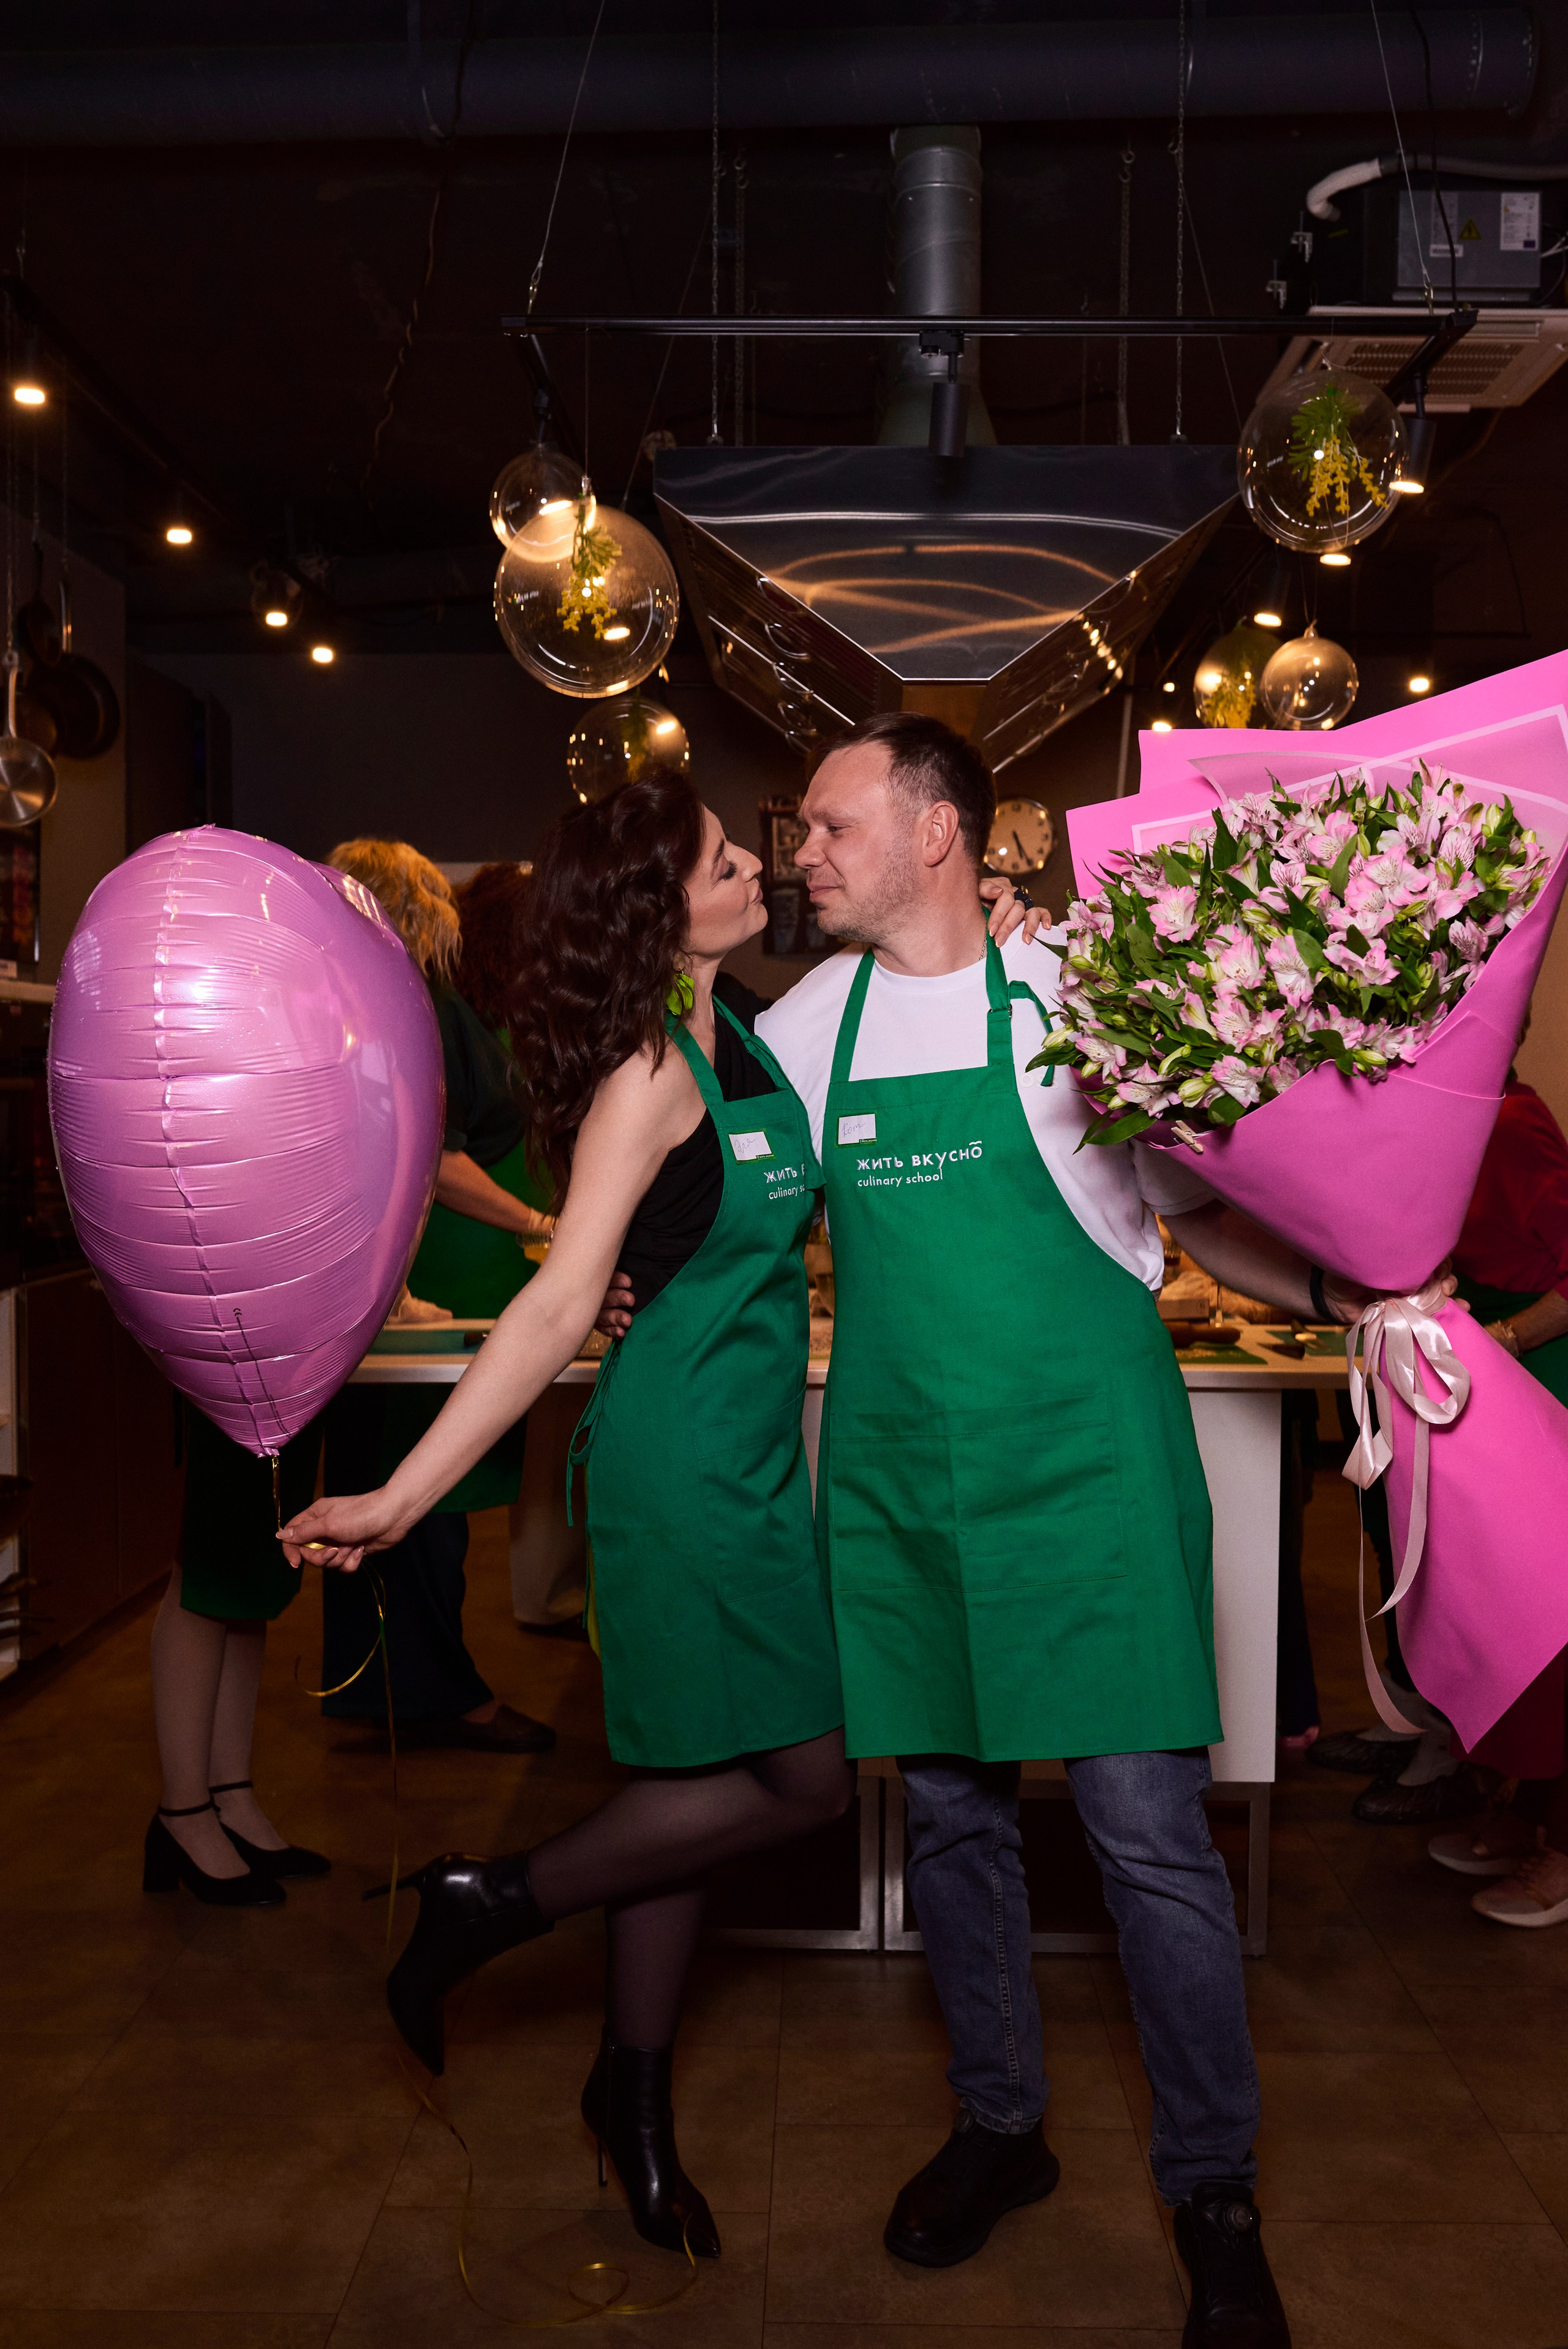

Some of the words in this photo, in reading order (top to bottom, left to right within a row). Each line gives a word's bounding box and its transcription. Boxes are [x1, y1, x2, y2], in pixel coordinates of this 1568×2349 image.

[858, 1175, 903, 1188] culinary
[906, 1168, 943, 1183] school
[768, 1186, 798, 1200] culinary
